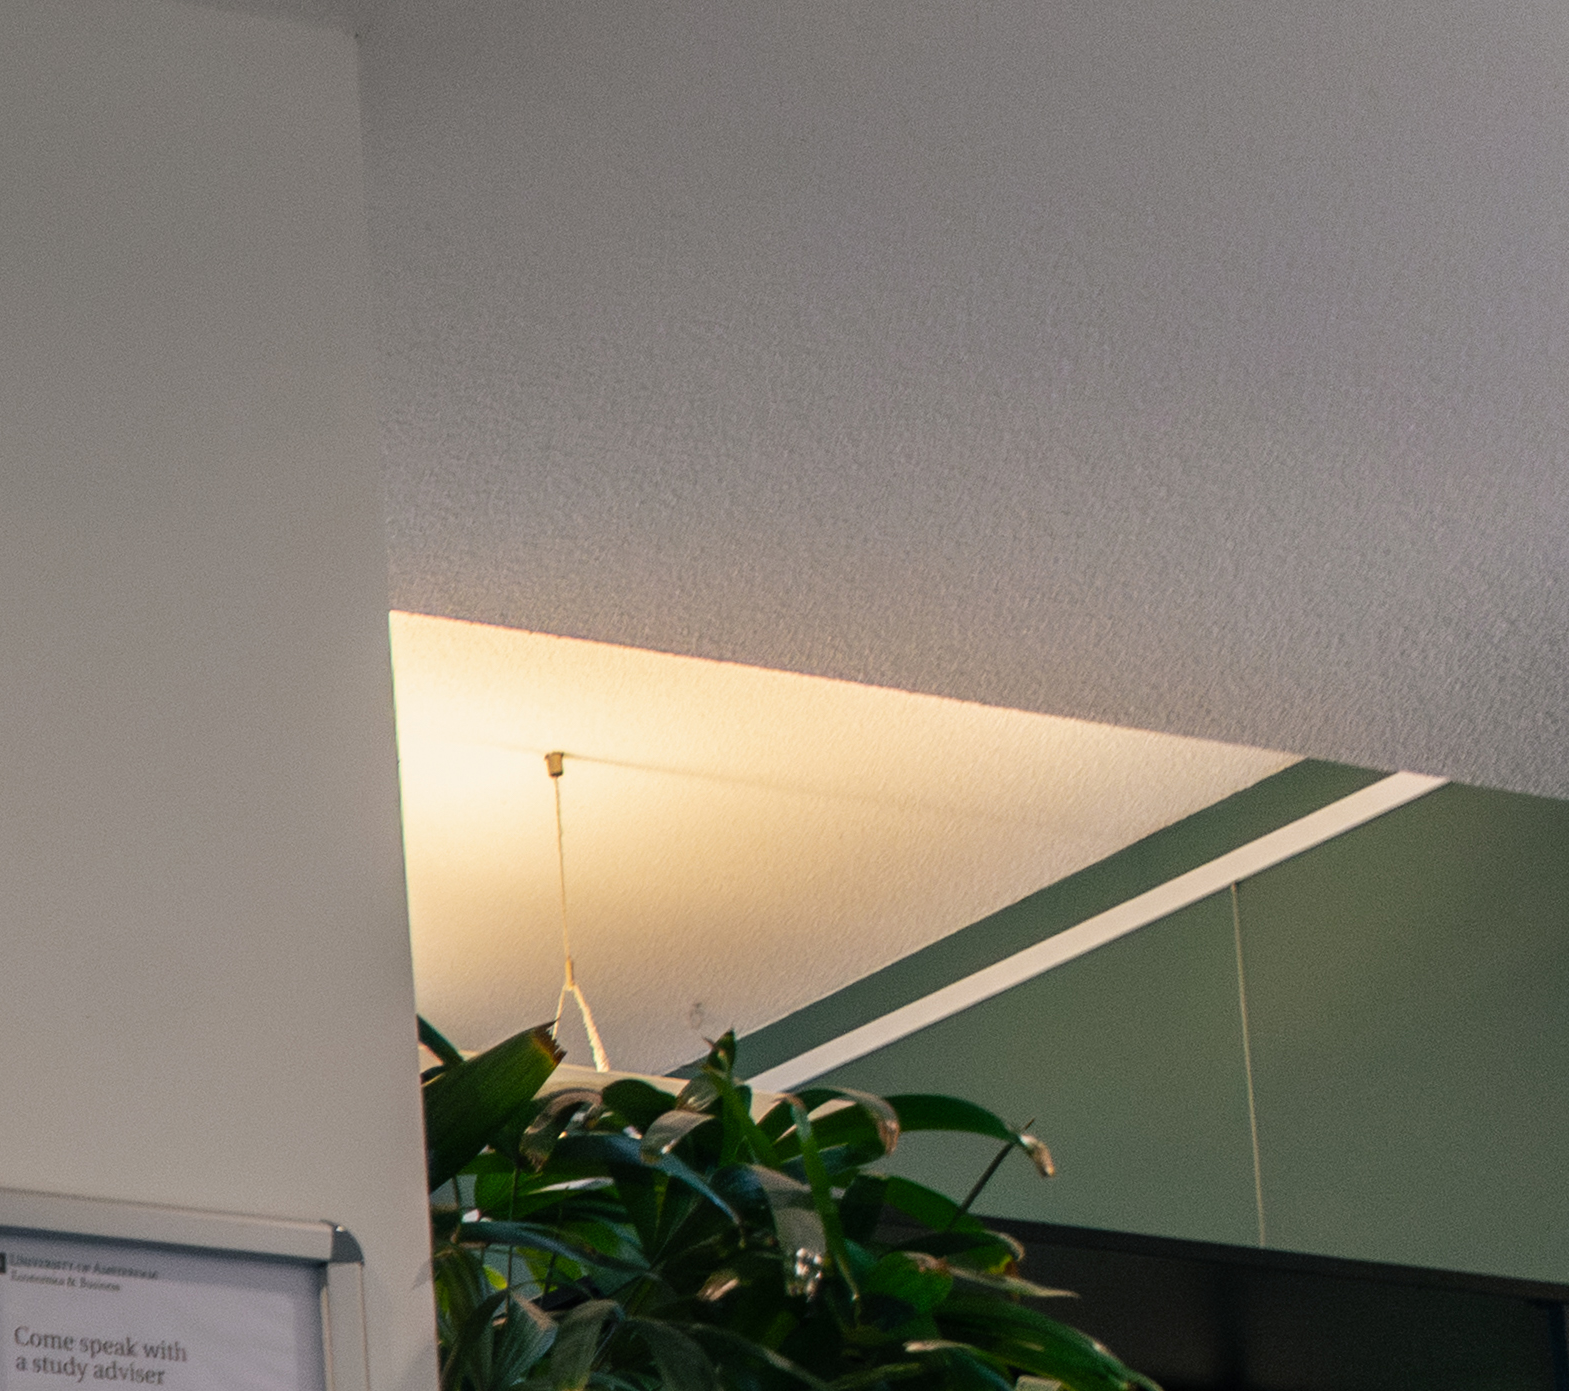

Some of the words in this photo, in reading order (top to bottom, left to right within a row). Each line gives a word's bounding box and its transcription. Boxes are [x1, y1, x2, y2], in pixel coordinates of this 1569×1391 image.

[14, 1327, 74, 1351] Come
[80, 1337, 136, 1358] speak
[143, 1341, 186, 1361] with
[16, 1357, 27, 1371] a
[33, 1357, 88, 1383] study
[93, 1361, 165, 1384] adviser
